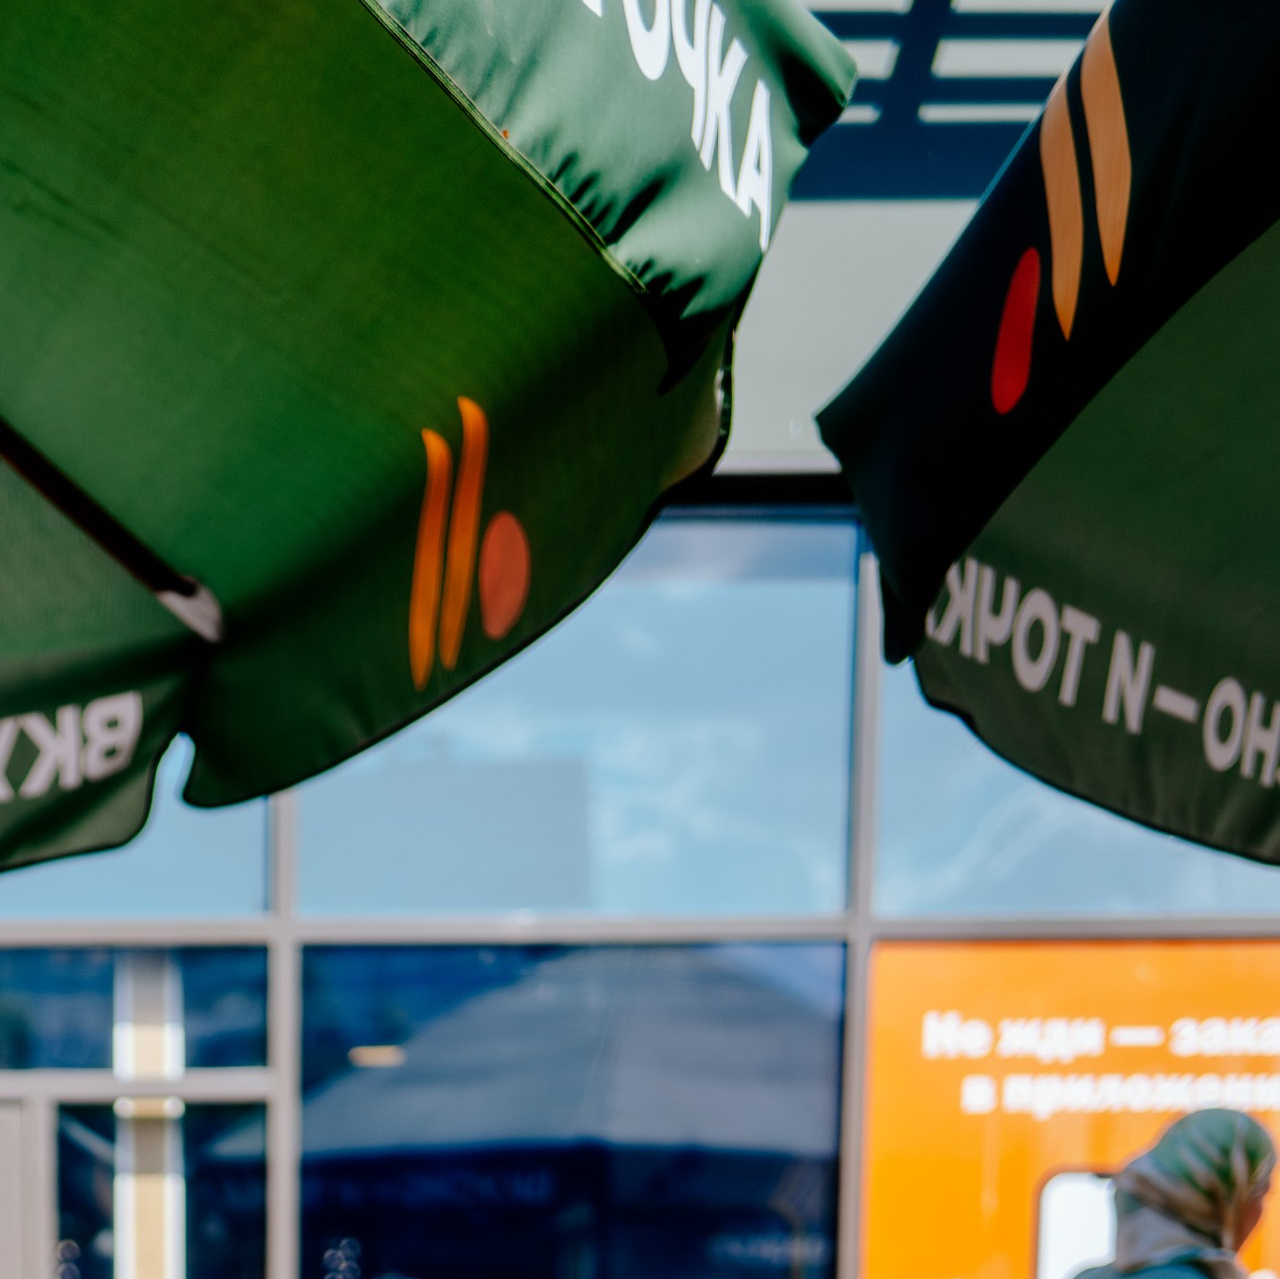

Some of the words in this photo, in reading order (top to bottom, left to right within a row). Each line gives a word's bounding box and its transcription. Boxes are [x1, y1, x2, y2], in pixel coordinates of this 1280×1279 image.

[921, 1009, 994, 1059] Не
[995, 1017, 1107, 1064] жди
[960, 1074, 997, 1115] в
